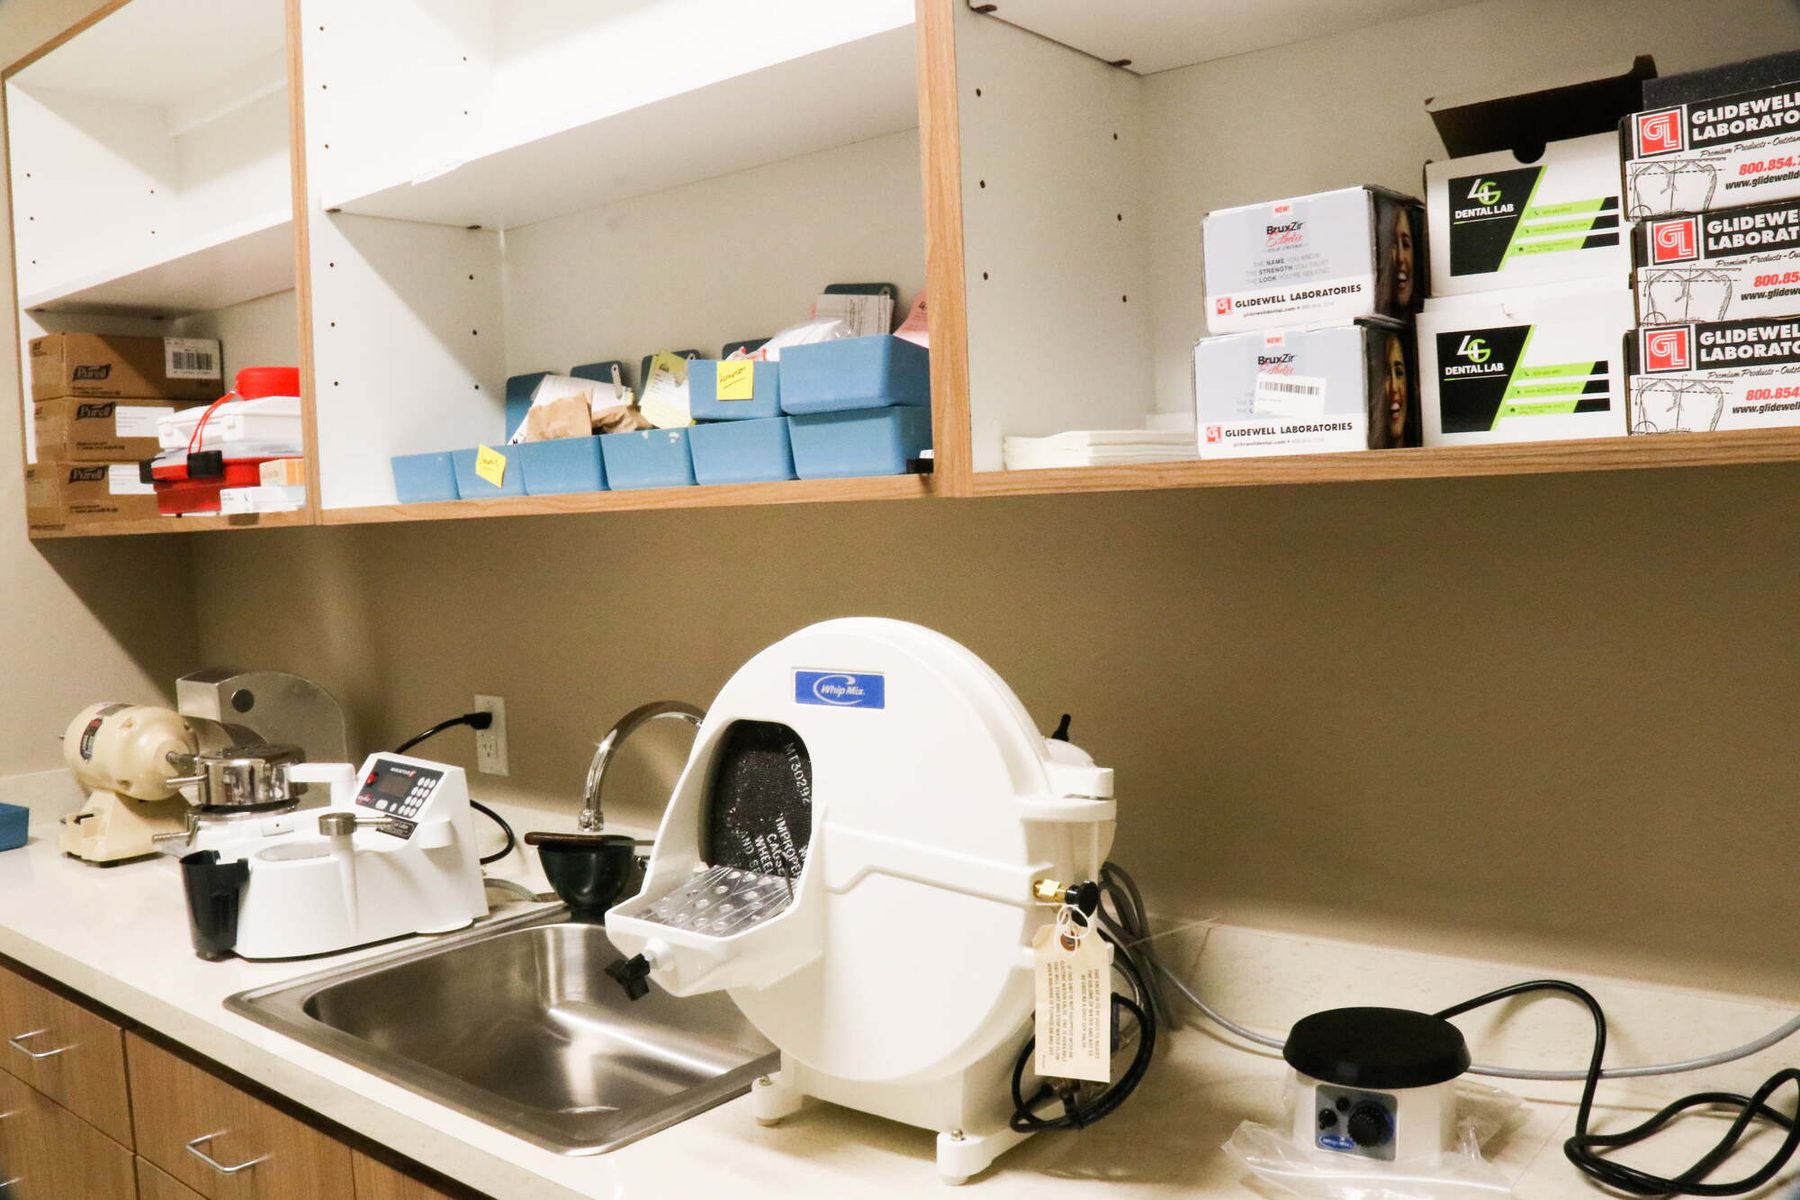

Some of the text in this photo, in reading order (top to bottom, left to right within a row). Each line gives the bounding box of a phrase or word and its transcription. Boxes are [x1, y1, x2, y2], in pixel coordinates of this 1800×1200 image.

[1739, 155, 1800, 176] 800.854.
[1455, 203, 1514, 219] DENTAL LAB
[1266, 221, 1304, 236] BruxZir
[1266, 258, 1285, 267] NAME
[1235, 295, 1286, 309] GLIDEWELL
[1290, 284, 1362, 301] LABORATORIES
[1258, 353, 1296, 366] BruxZir
[1445, 362, 1505, 376] DENTAL LAB
[1225, 422, 1353, 438] GLIDEWELL LABORATORIES
[821, 685, 845, 698] Whip
